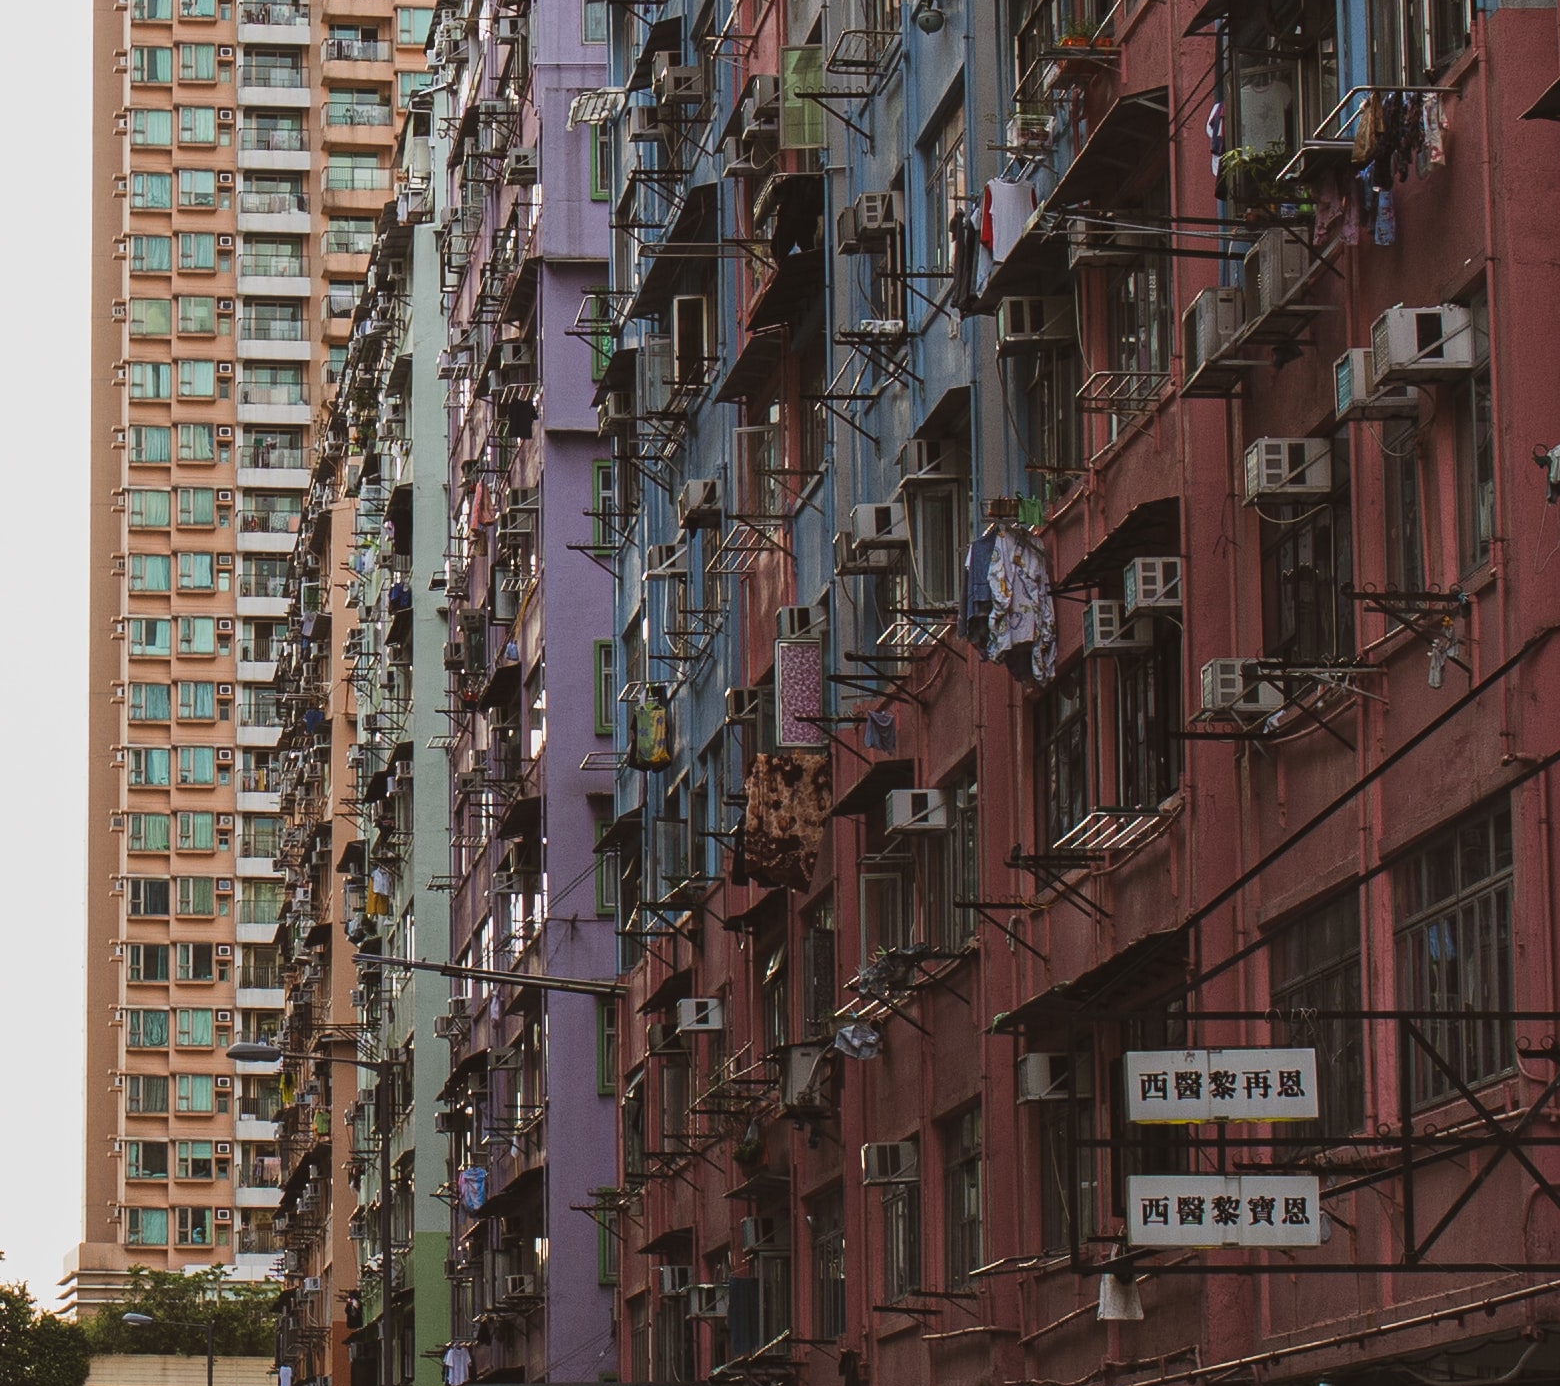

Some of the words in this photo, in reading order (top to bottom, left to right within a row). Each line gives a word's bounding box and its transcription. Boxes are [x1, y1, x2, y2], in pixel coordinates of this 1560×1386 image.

[1138, 1069, 1306, 1101] 西醫黎再恩
[1140, 1195, 1311, 1227] 西醫黎寶恩
